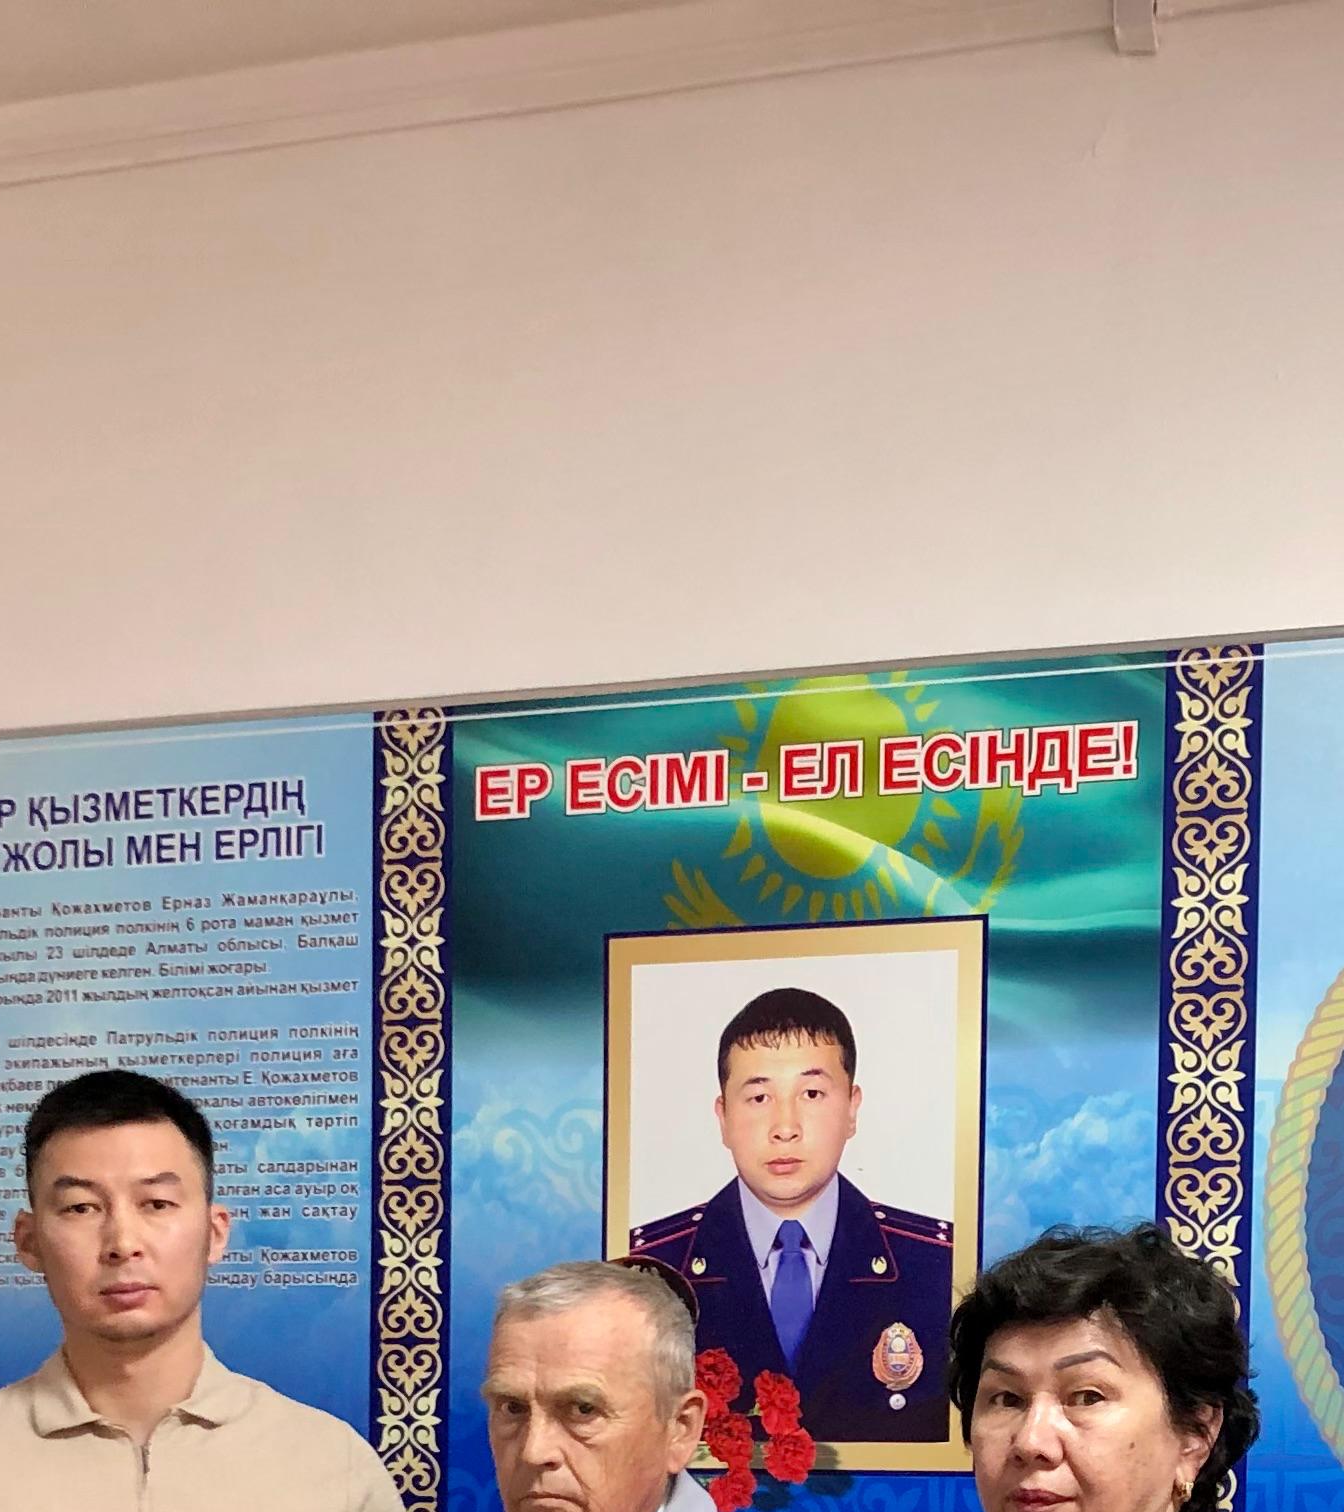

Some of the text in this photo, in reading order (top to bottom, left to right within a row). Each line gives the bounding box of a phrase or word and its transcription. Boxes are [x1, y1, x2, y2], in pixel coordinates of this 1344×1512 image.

[477, 764, 552, 821] ЕР
[565, 749, 729, 815] ЕСІМІ
[779, 740, 865, 802] ЕЛ
[878, 720, 1139, 797] ЕСІНДЕ!
[29, 779, 307, 832] ҚЫЗМЕТКЕРДІҢ
[3, 835, 114, 873] ЖОЛЫ
[127, 831, 202, 866] МЕН
[215, 824, 325, 860] ЕРЛІГІ
[162, 896, 212, 913] Ерназ
[44, 923, 110, 940] полиция
[186, 917, 196, 932] 6
[201, 919, 237, 933] рота
[244, 915, 294, 928] маман
[45, 946, 64, 960] 23
[145, 941, 208, 956] Алматы
[46, 989, 79, 1003] 2011
[106, 1030, 199, 1047] Патрульдік
[207, 1027, 279, 1042] полиция
[250, 1047, 322, 1064] полиция
[156, 1072, 239, 1089] ейтенанты
[257, 1160, 358, 1177] салдарынан
[264, 1183, 291, 1196] аса
[295, 1182, 337, 1198] ауыр
[259, 1206, 291, 1217] жан
[261, 1248, 359, 1264] Қожахметов
[263, 1269, 358, 1287] барысында
